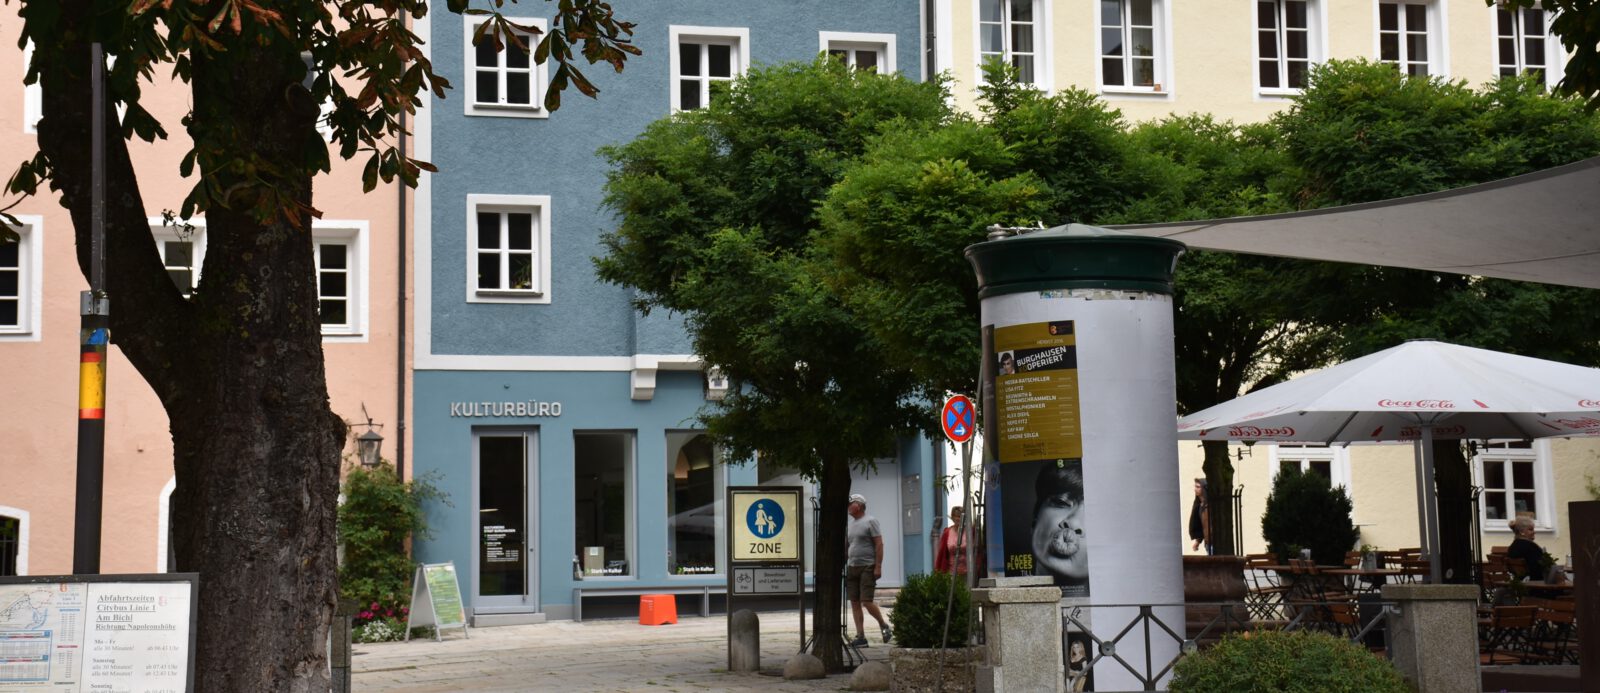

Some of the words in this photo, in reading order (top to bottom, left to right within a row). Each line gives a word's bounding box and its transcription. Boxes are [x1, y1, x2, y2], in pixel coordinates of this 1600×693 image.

[1016, 346, 1066, 366] BURGHAUSEN
[450, 399, 562, 417] KULTURBÜRO
[1378, 399, 1456, 409] Coca-Cola
[750, 542, 782, 554] ZONE
[1010, 554, 1032, 562] FACES
